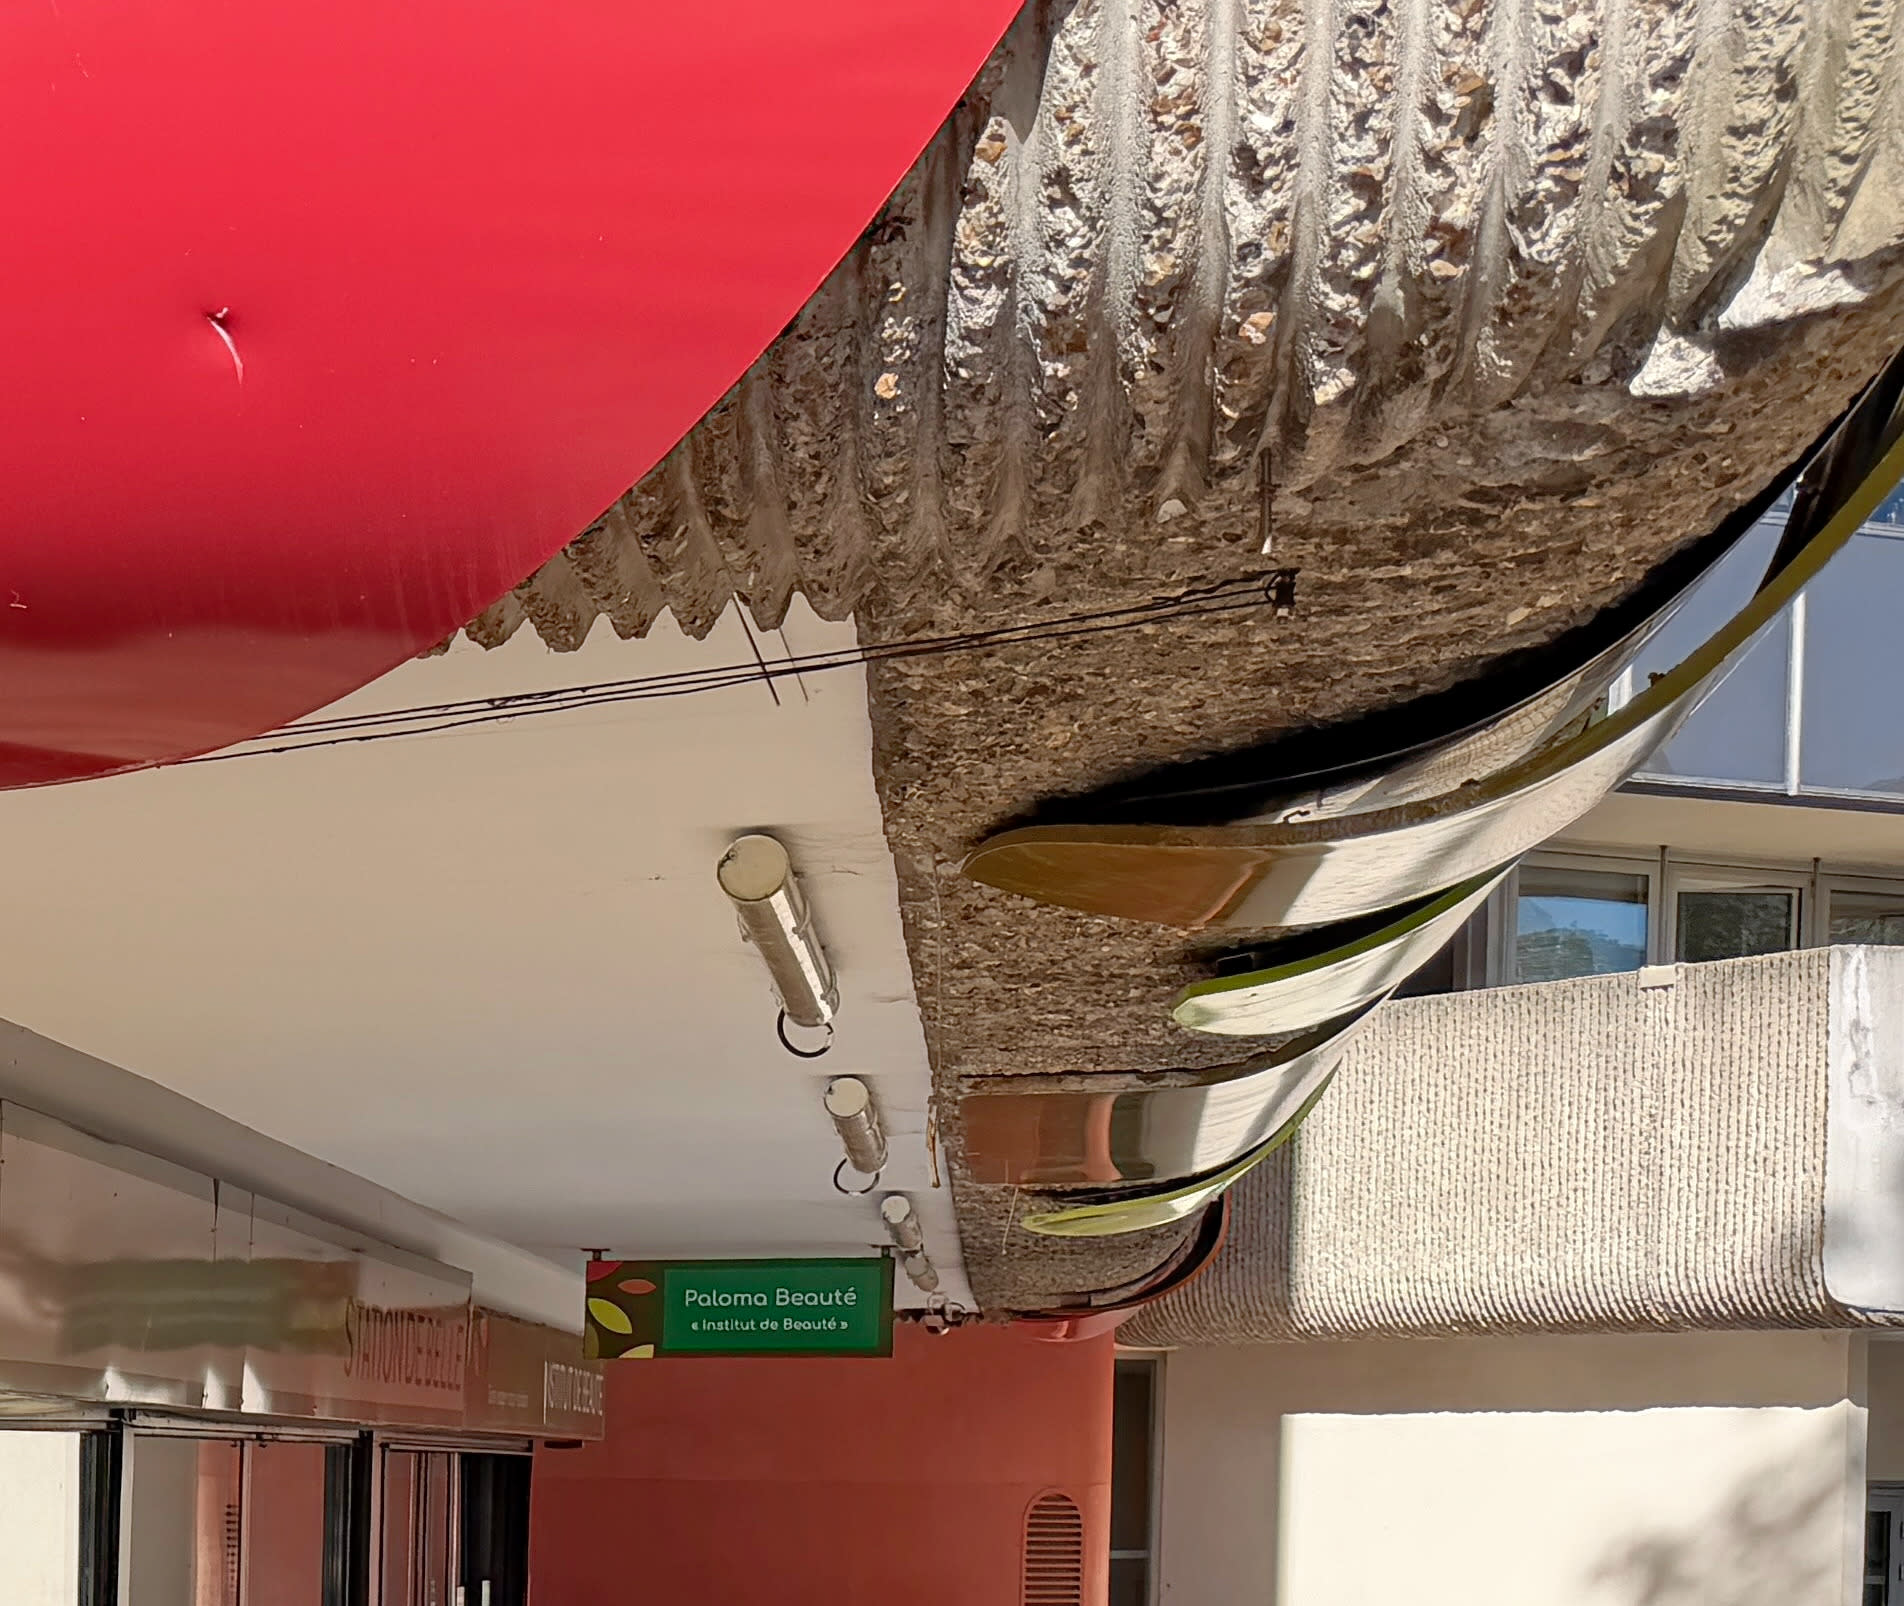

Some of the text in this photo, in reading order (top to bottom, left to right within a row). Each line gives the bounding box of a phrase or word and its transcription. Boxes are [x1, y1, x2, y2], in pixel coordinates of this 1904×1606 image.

[684, 1286, 858, 1308] Paloma Beauté
[702, 1317, 757, 1332] Institut
[759, 1317, 779, 1331] de
[783, 1316, 838, 1332] Beauté
